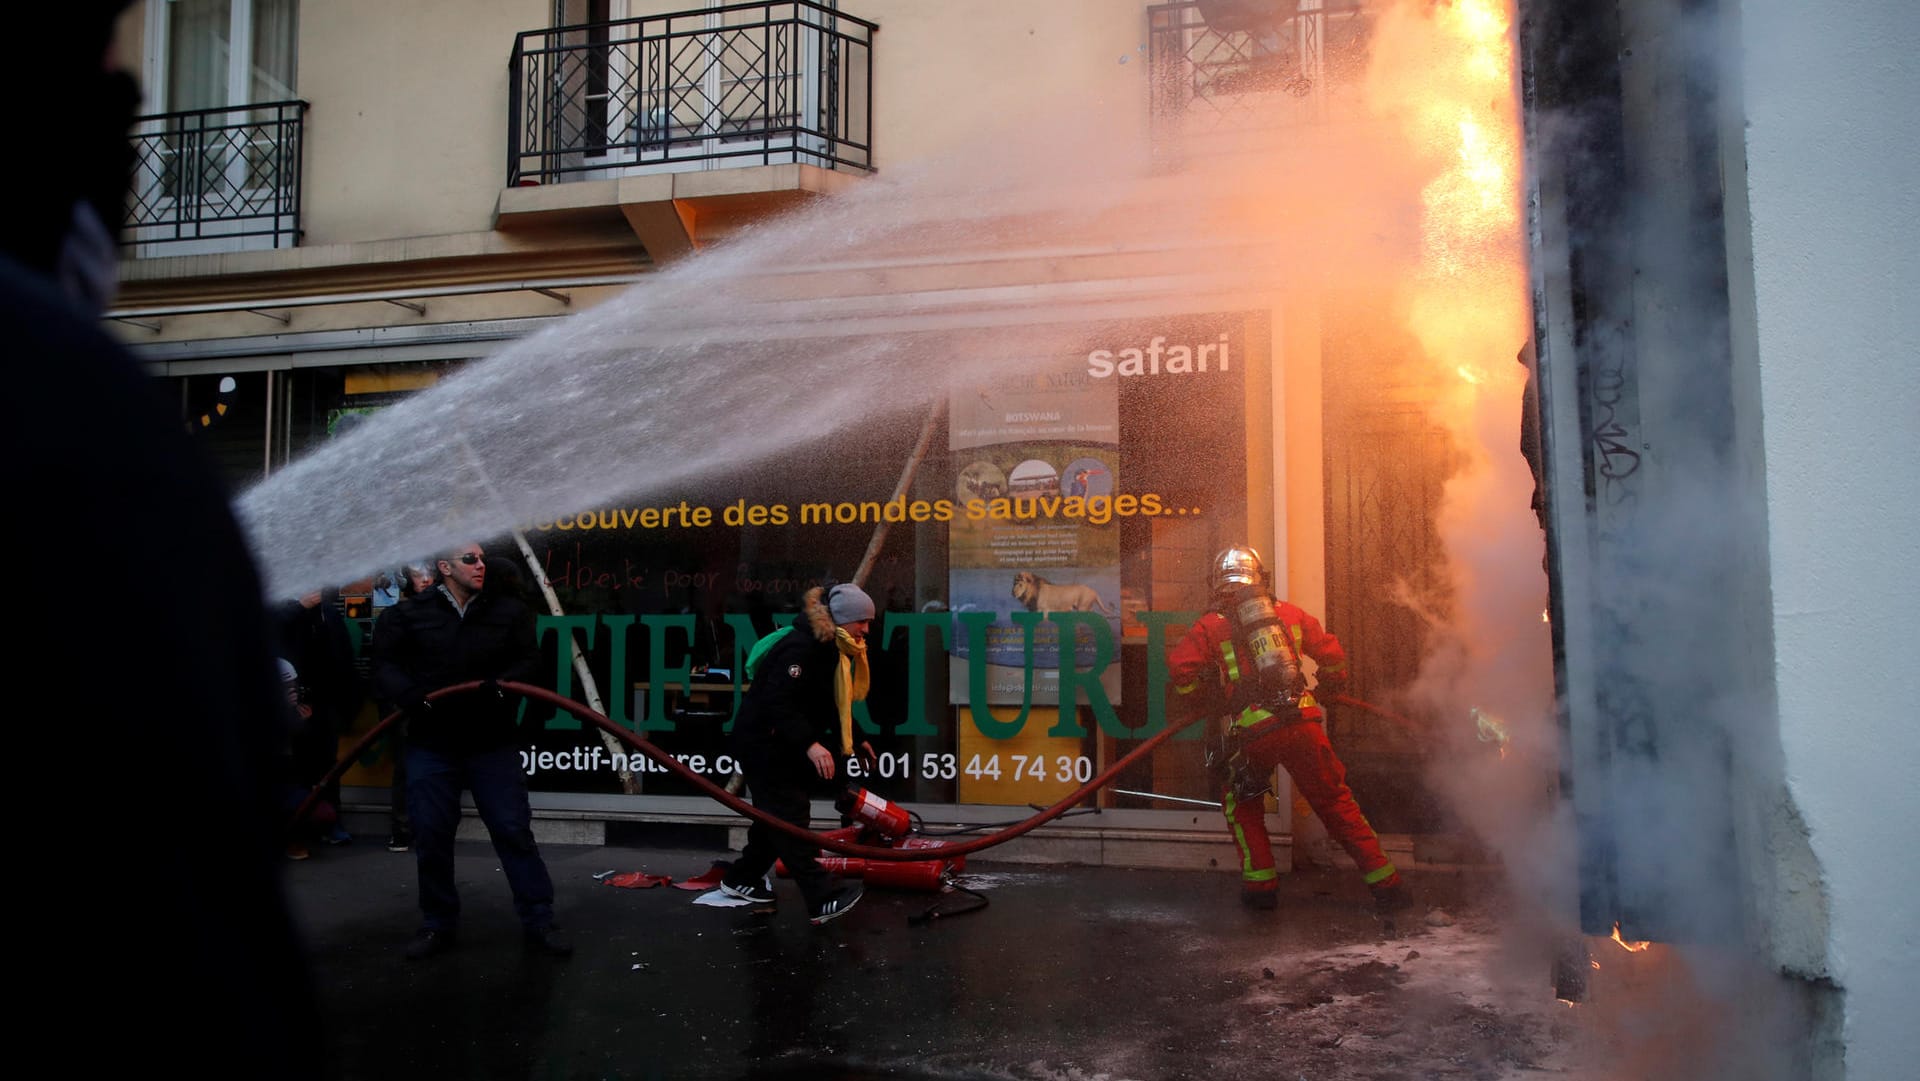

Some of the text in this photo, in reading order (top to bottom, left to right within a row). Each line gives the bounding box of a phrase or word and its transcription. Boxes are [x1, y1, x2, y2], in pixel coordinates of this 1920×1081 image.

[1087, 333, 1229, 378] safari
[1005, 411, 1061, 422] BOTSWANA
[723, 499, 790, 526] des
[801, 495, 954, 524] mondes
[966, 492, 1201, 525] sauvages...
[878, 751, 910, 779] 01
[921, 752, 957, 780] 53
[964, 753, 1002, 782] 44
[1011, 754, 1047, 782] 74
[1055, 755, 1092, 783] 30
